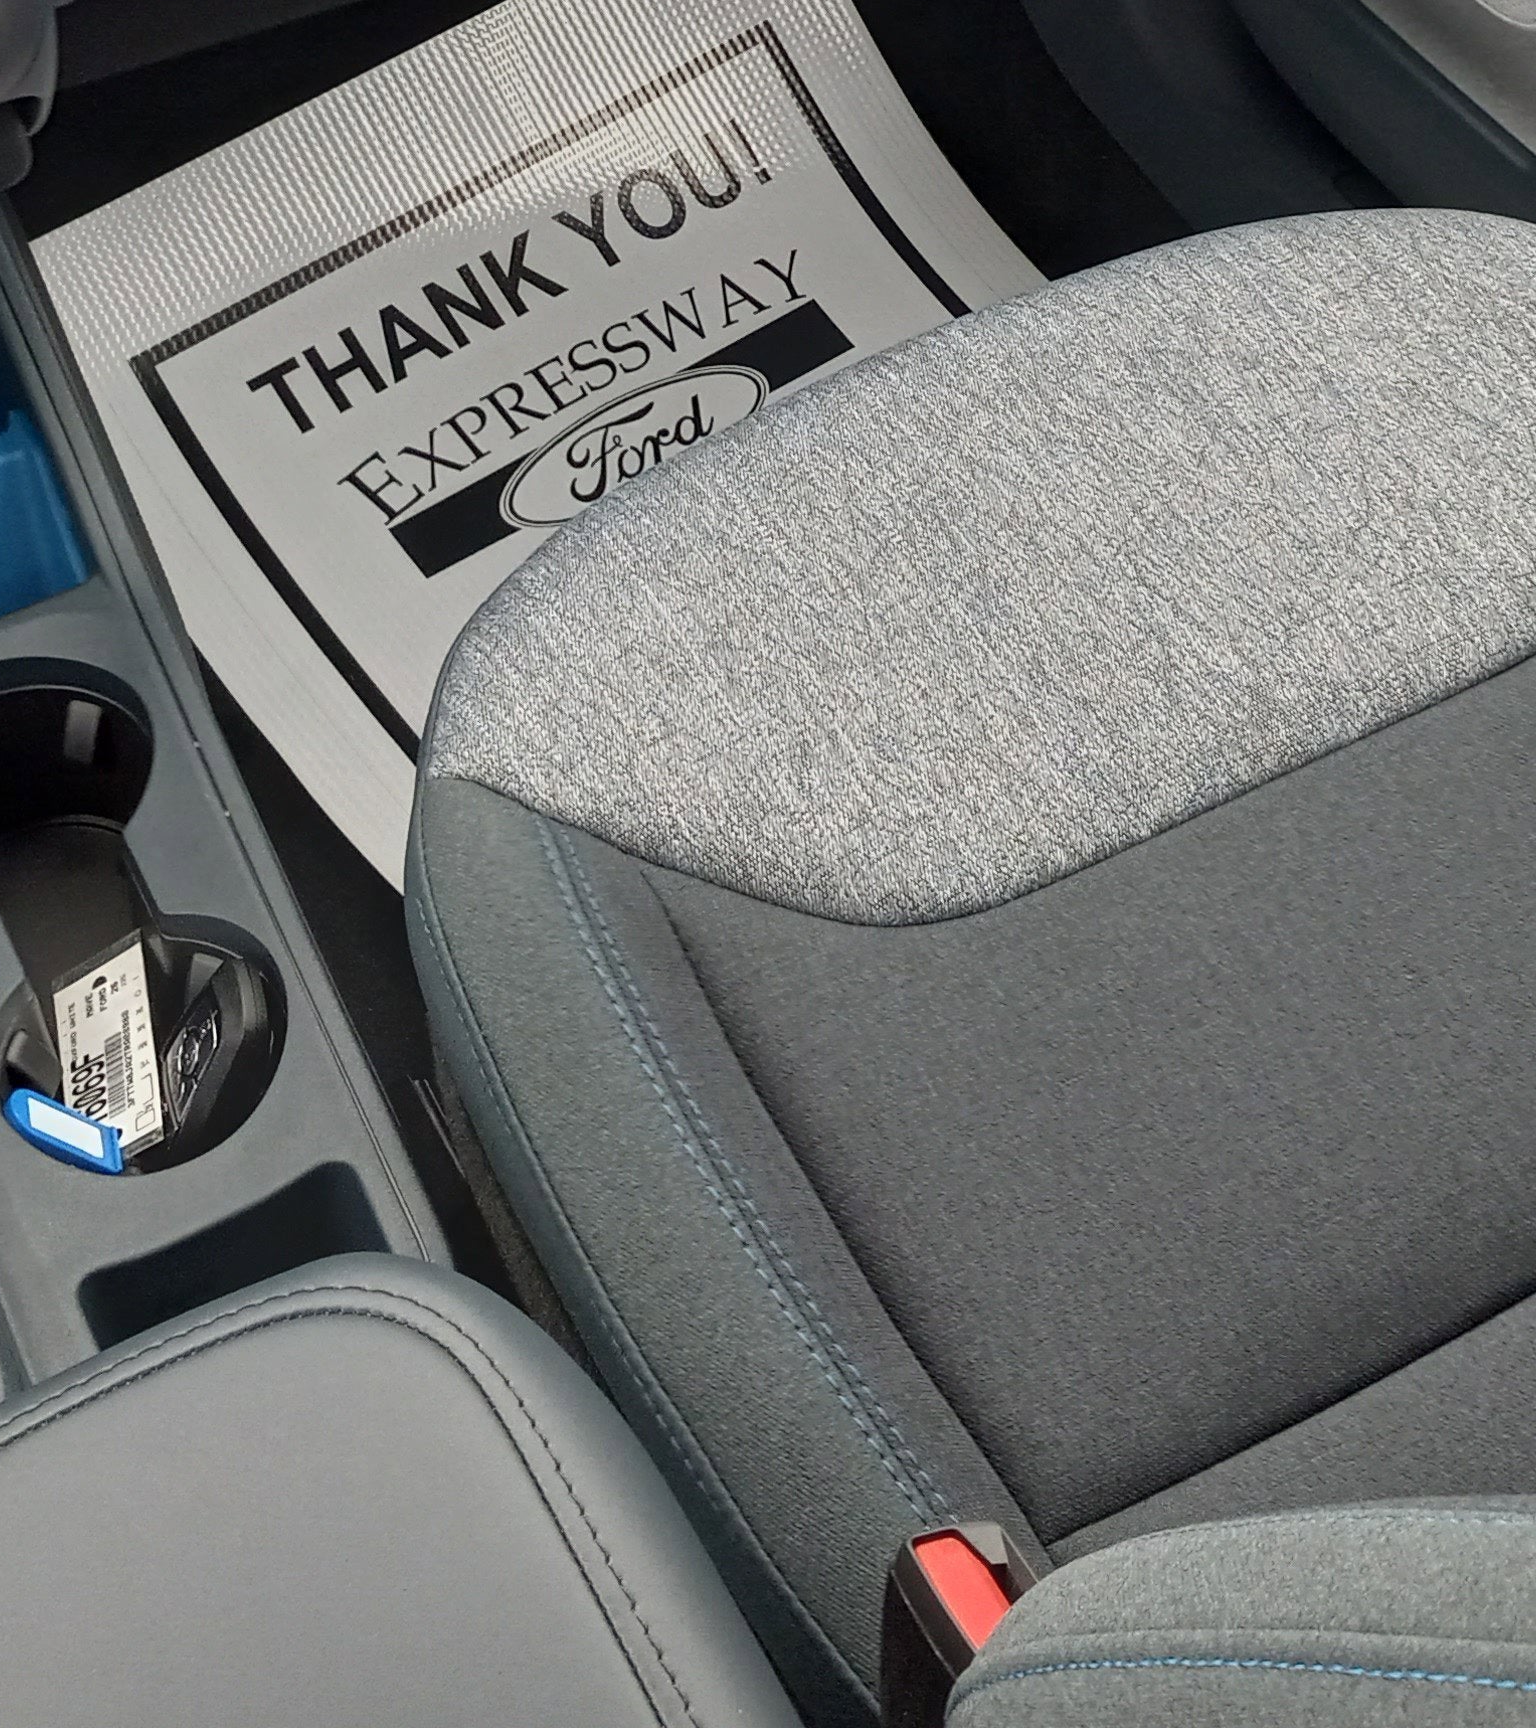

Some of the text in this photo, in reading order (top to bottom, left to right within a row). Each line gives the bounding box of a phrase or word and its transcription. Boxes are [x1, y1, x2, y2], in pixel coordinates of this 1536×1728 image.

[245, 117, 773, 435] THANK YOU!
[337, 248, 808, 528] EXPRESSWAY
[566, 394, 715, 504] Ford
